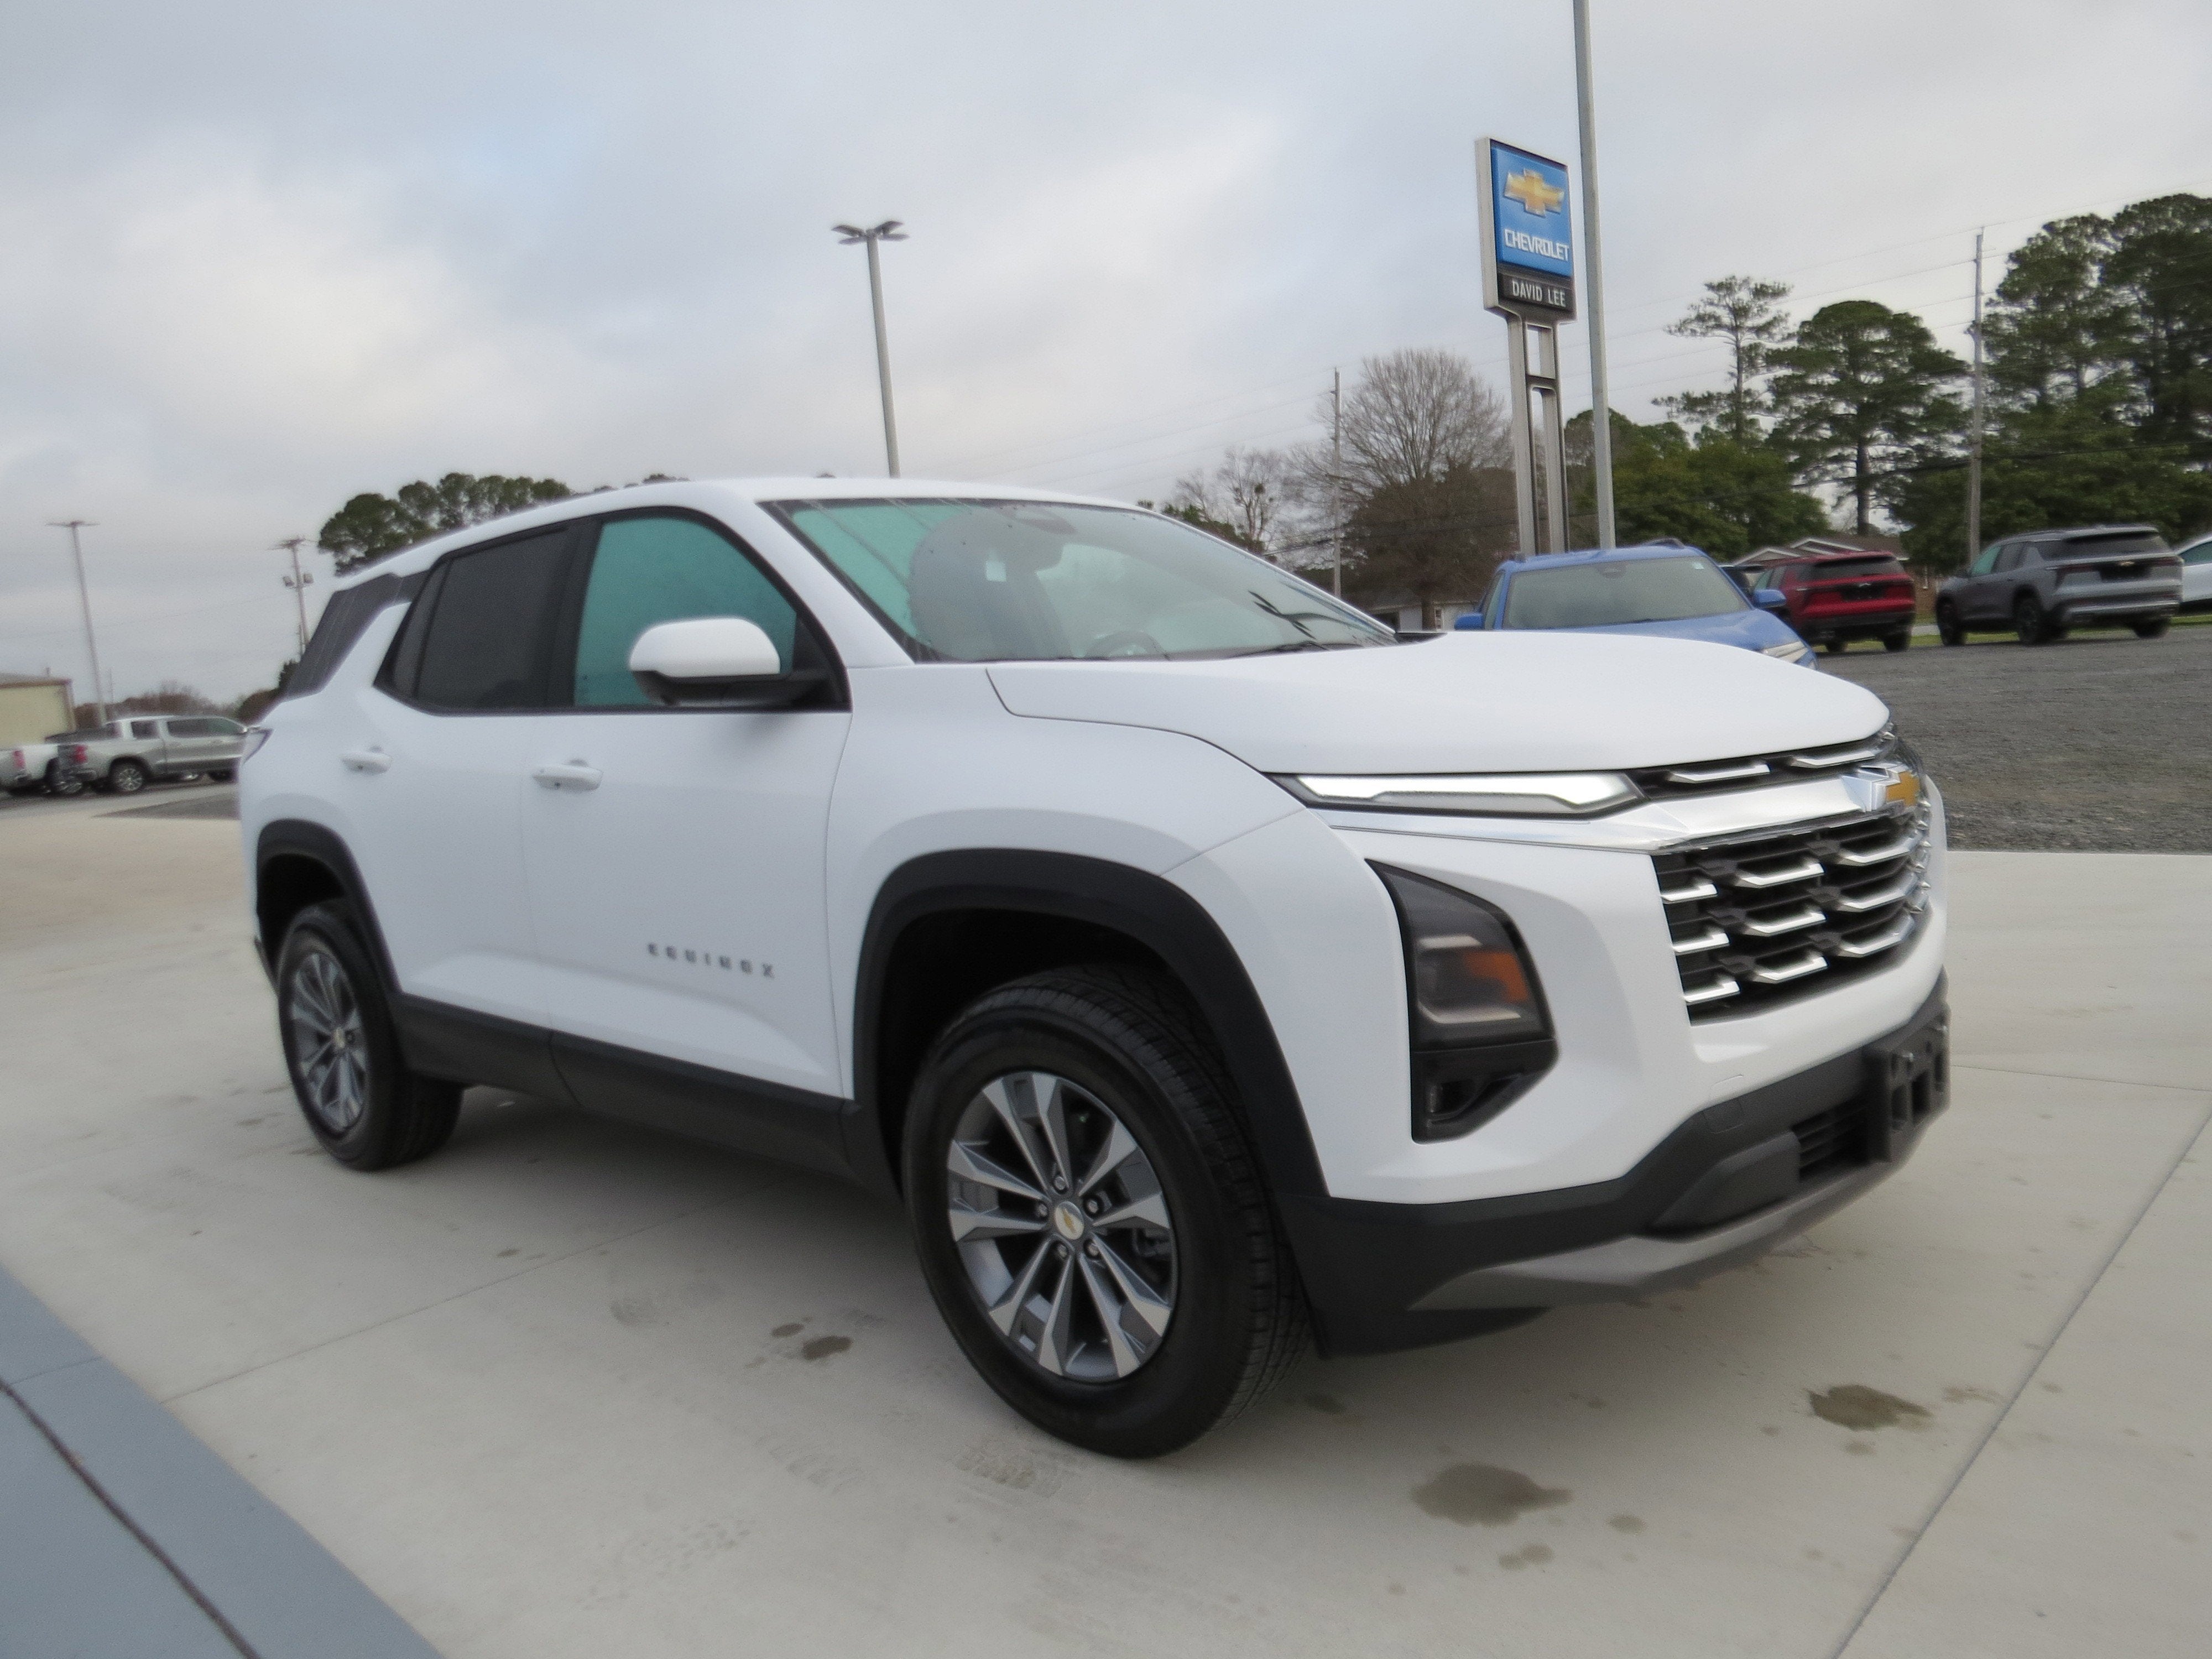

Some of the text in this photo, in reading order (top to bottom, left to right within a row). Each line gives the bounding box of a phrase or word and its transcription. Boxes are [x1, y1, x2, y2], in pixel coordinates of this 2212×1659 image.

[1505, 228, 1569, 261] CHEVROLET
[1512, 280, 1566, 307] DAVID LEE
